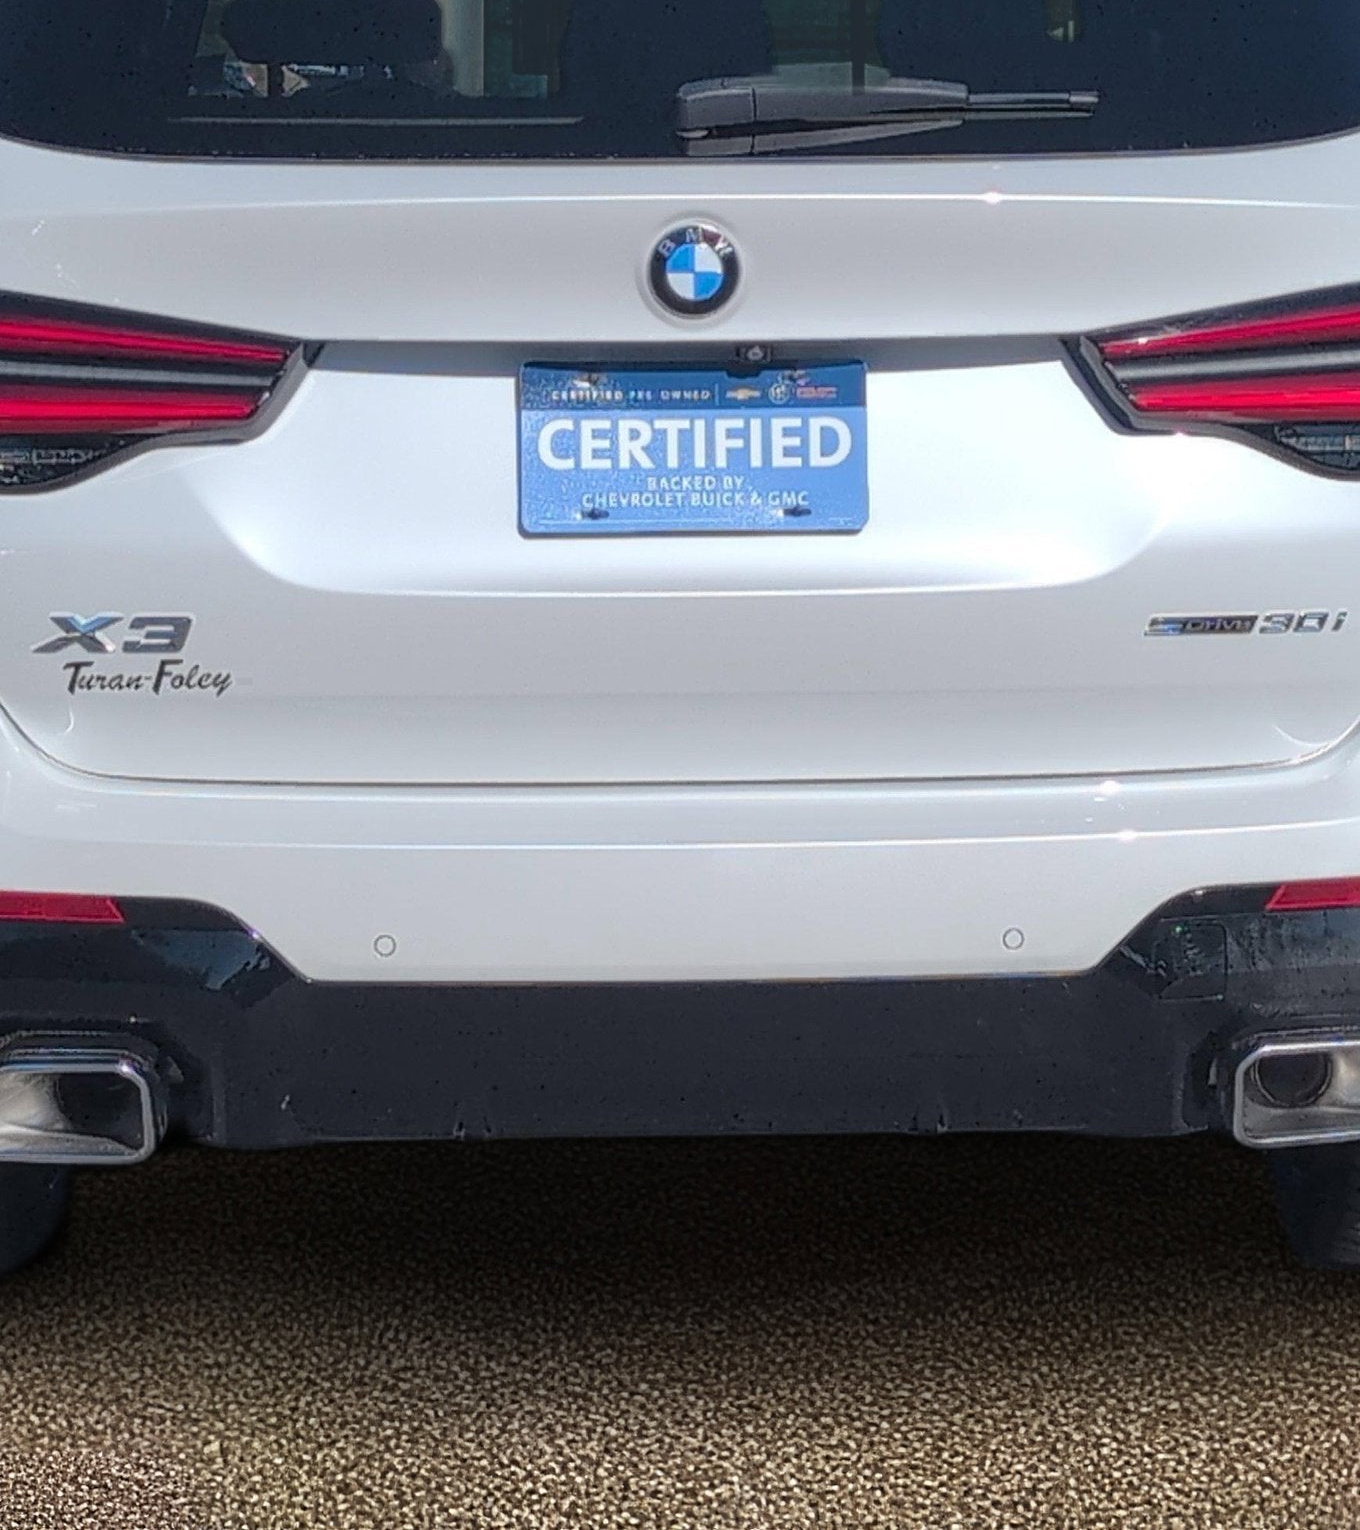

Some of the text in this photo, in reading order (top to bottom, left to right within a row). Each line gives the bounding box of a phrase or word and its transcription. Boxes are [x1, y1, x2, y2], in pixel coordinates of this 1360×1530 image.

[658, 227, 733, 258] BMW
[537, 417, 852, 469] CERTIFIED
[647, 475, 745, 491] BACKED BY
[582, 491, 809, 508] CHEVROLET BUICK & GMC
[31, 611, 195, 653] X3
